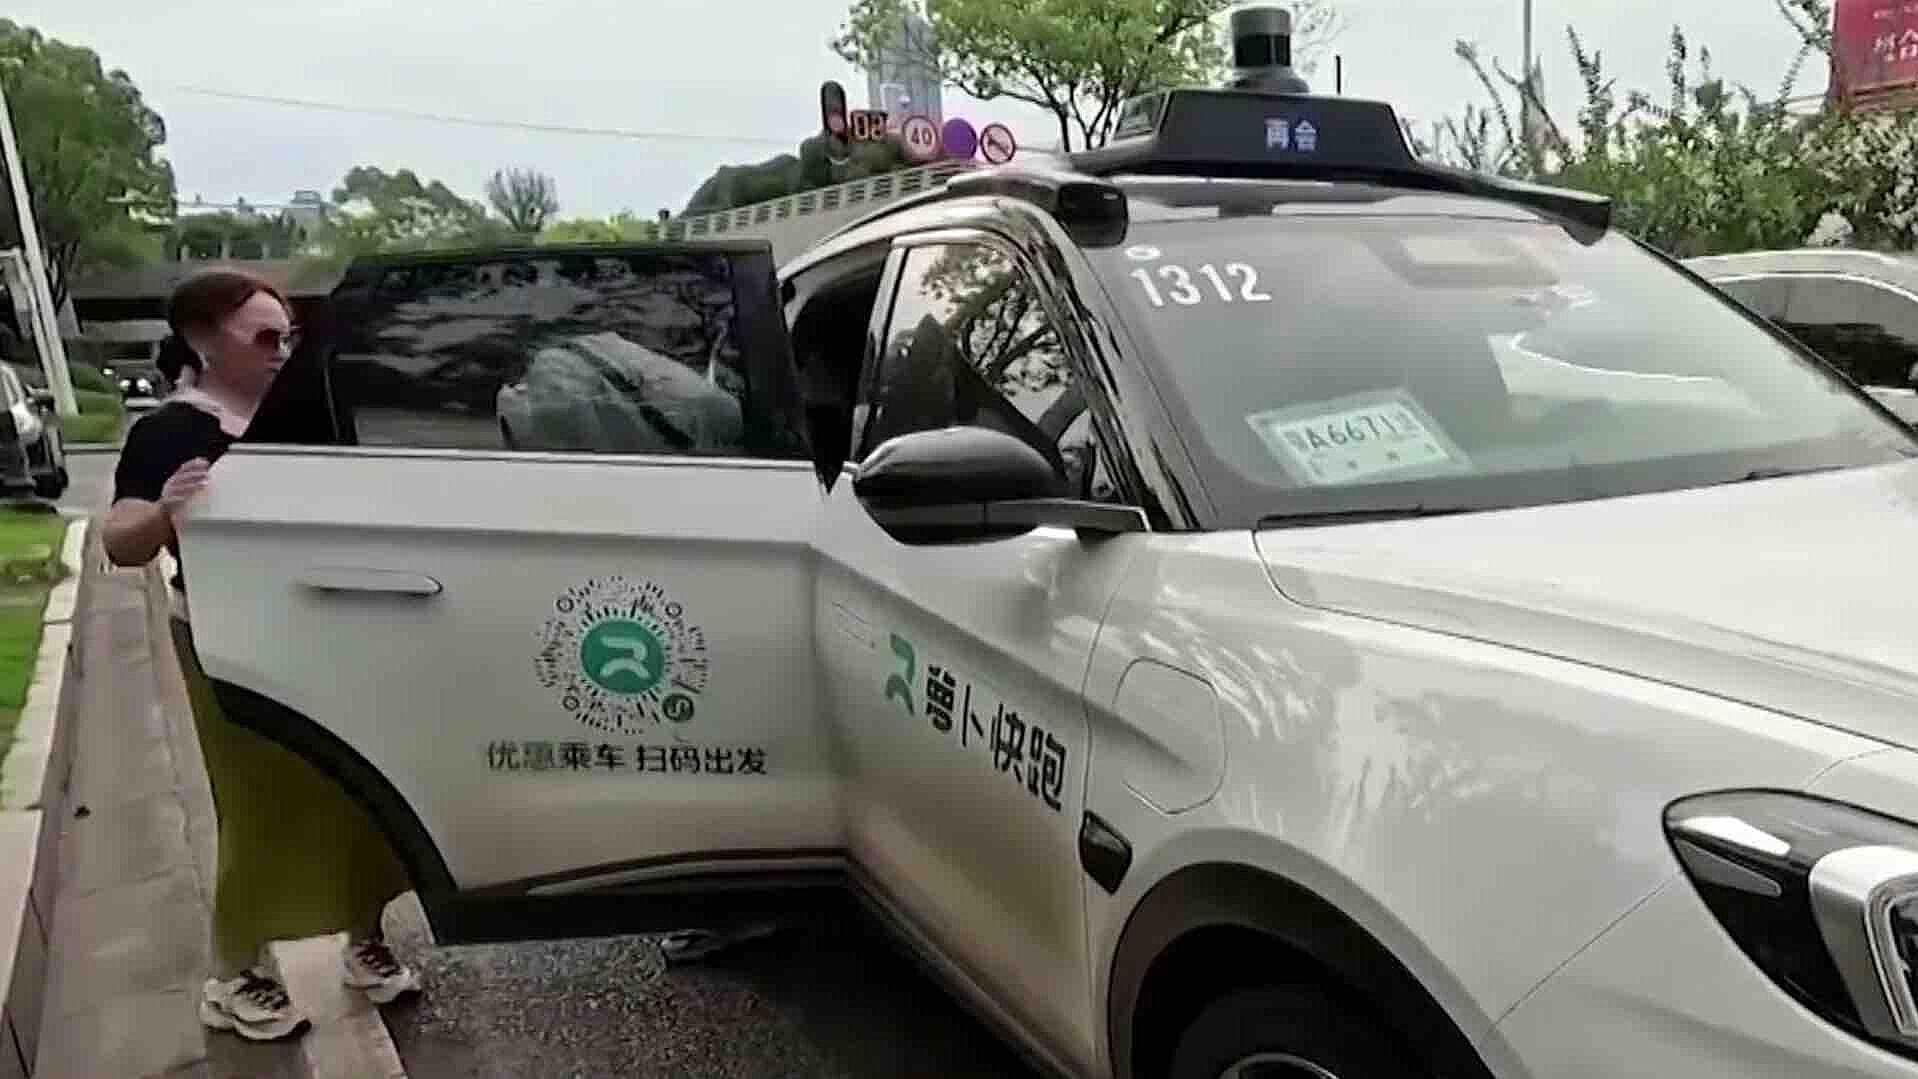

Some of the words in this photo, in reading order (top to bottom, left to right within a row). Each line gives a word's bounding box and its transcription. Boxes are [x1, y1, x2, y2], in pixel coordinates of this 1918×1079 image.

[910, 126, 932, 145] 40
[1130, 262, 1272, 308] 1312
[636, 743, 769, 775] 扫码出发
